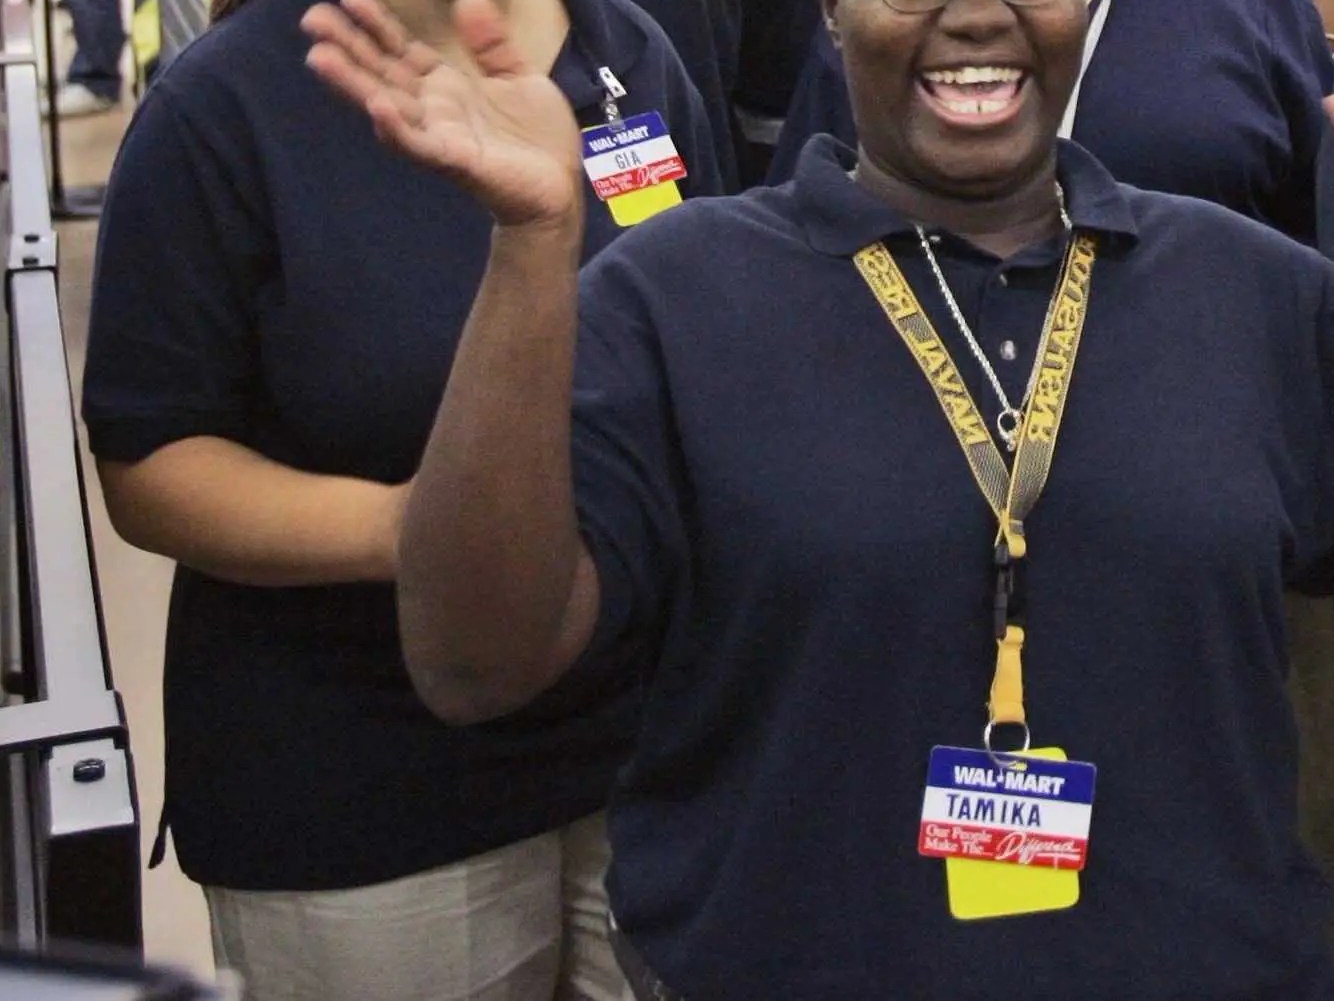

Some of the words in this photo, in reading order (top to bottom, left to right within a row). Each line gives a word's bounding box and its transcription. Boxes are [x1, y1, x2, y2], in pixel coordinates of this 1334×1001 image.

[614, 150, 643, 170] GIA
[946, 793, 1041, 828] TAMIKA
[926, 824, 950, 838] Our
